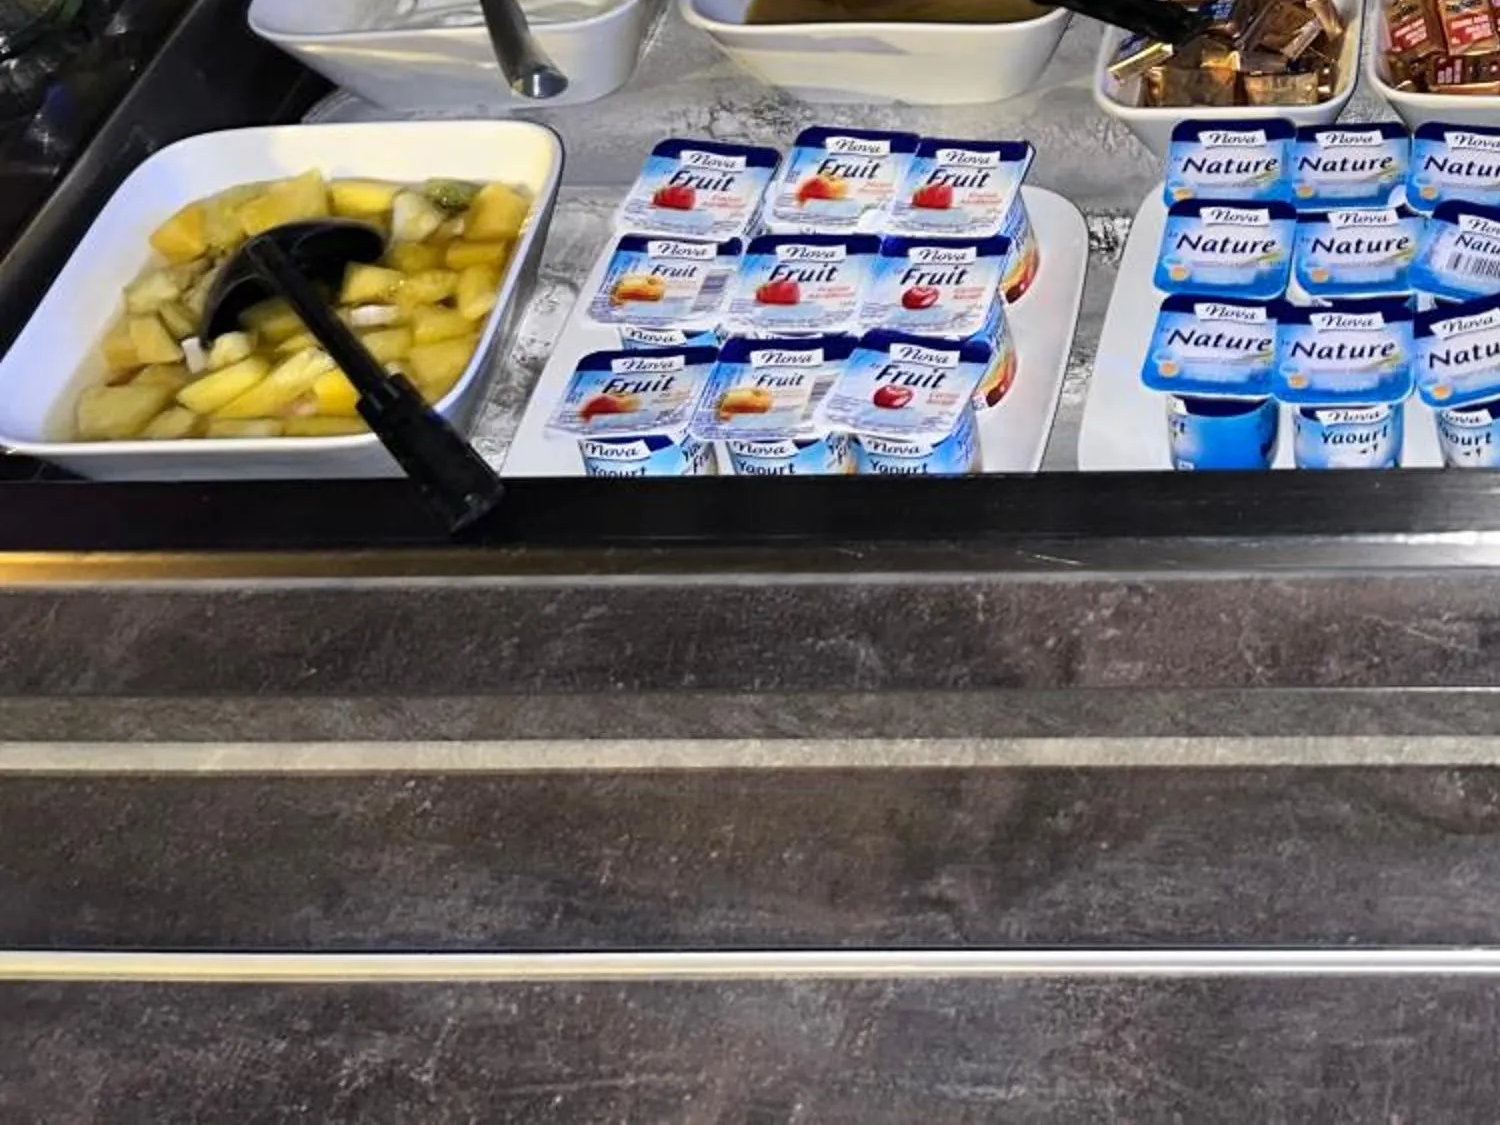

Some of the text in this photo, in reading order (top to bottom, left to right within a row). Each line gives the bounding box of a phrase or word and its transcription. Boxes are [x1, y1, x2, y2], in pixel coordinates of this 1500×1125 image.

[1210, 132, 1257, 144] Nova
[1326, 132, 1373, 144] Nova
[835, 139, 882, 154] Nova
[690, 152, 736, 169] Nova
[945, 150, 992, 165] Nova
[1182, 156, 1278, 174] Nature
[1297, 155, 1393, 172] Nature
[817, 157, 881, 179] Fruit
[669, 170, 735, 191] Fruit
[926, 167, 991, 188] Fruit
[1209, 210, 1260, 222] Nova
[1338, 211, 1391, 224] Nova
[656, 242, 708, 256] Nova
[1176, 234, 1277, 253] Nature
[1311, 236, 1409, 254] Nature
[786, 246, 836, 259] Nova
[919, 248, 967, 261] Nova
[651, 264, 698, 278] Fruit
[768, 262, 839, 282] Fruit
[900, 266, 968, 285] Fruit
[1205, 304, 1257, 320] Nova
[1321, 314, 1374, 327] Nova
[1441, 314, 1495, 332] Nova
[1167, 328, 1273, 352] Nature
[761, 351, 814, 365] Nova
[901, 346, 951, 364] Nova
[1291, 340, 1396, 360] Nature
[622, 358, 675, 371] Nova
[602, 374, 675, 394] Fruit
[756, 373, 804, 387] Fruit
[875, 364, 946, 388] Fruit
[1321, 425, 1388, 445] Yaourt
[585, 441, 639, 457] Nova
[734, 440, 787, 456] Nova
[867, 439, 920, 455] Nova
